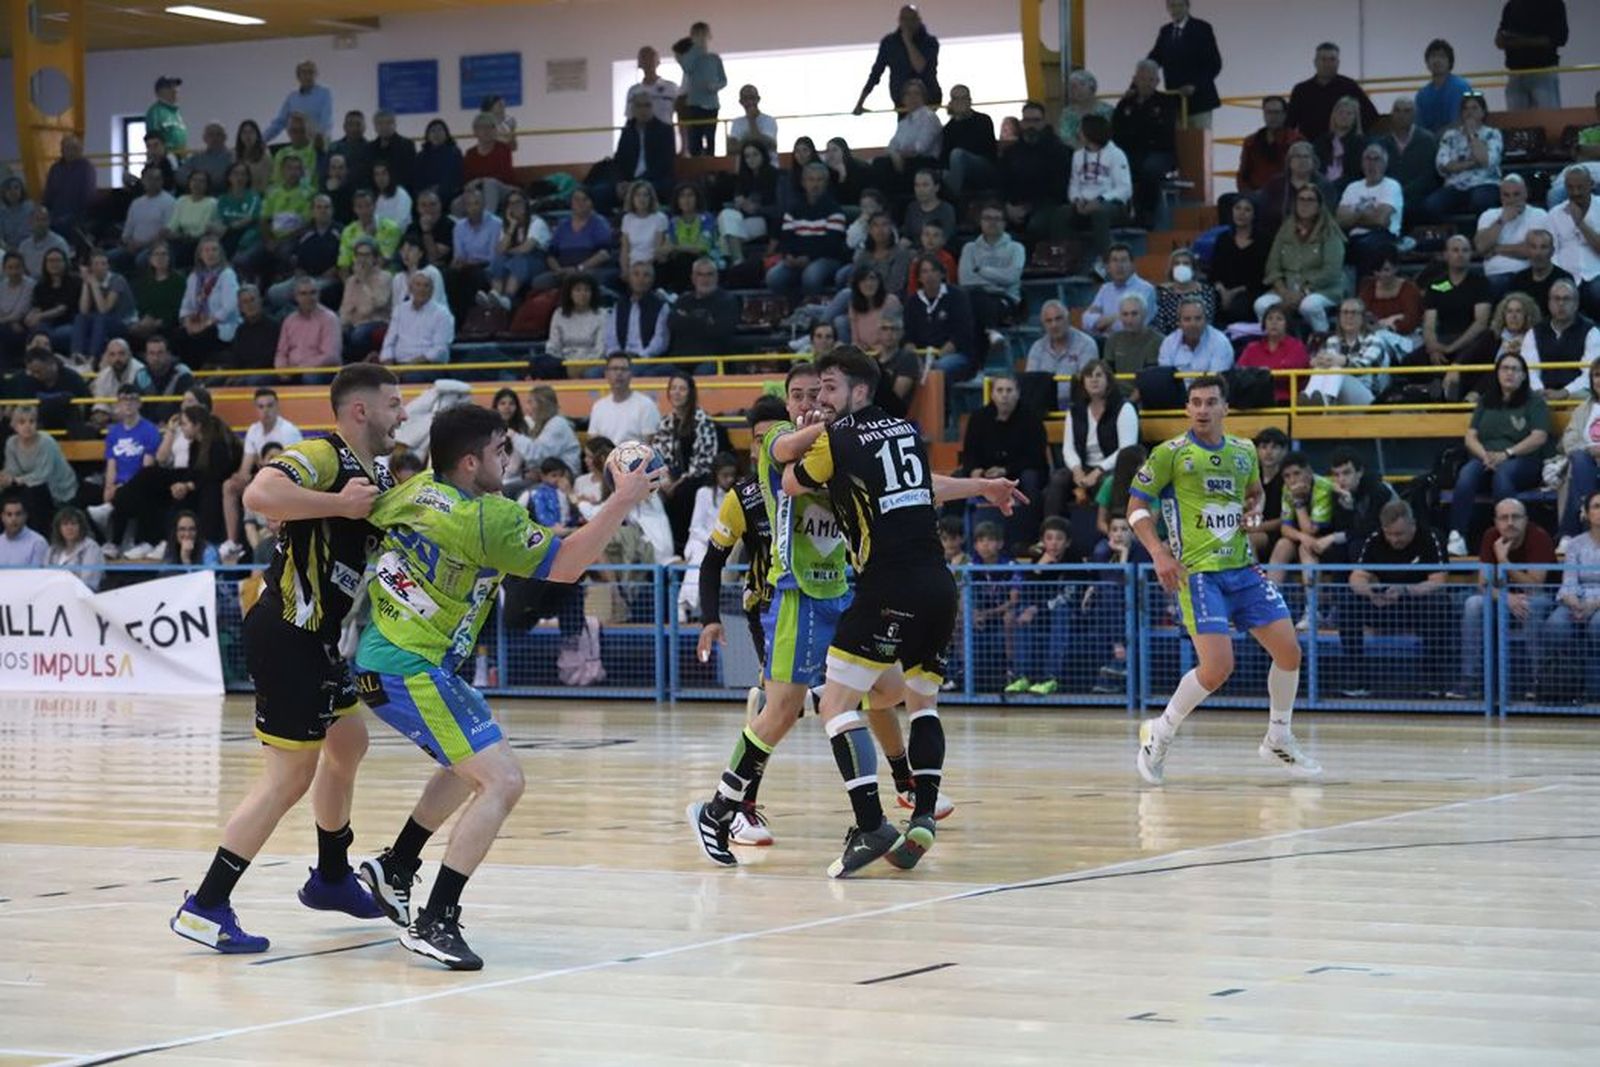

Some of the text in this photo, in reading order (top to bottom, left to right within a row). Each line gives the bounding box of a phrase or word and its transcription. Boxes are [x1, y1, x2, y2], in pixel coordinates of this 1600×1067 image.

[875, 435, 924, 492] 15
[793, 515, 843, 539] ZAMO
[95, 611, 110, 647] Y
[0, 651, 134, 682] OS IMPULSA
